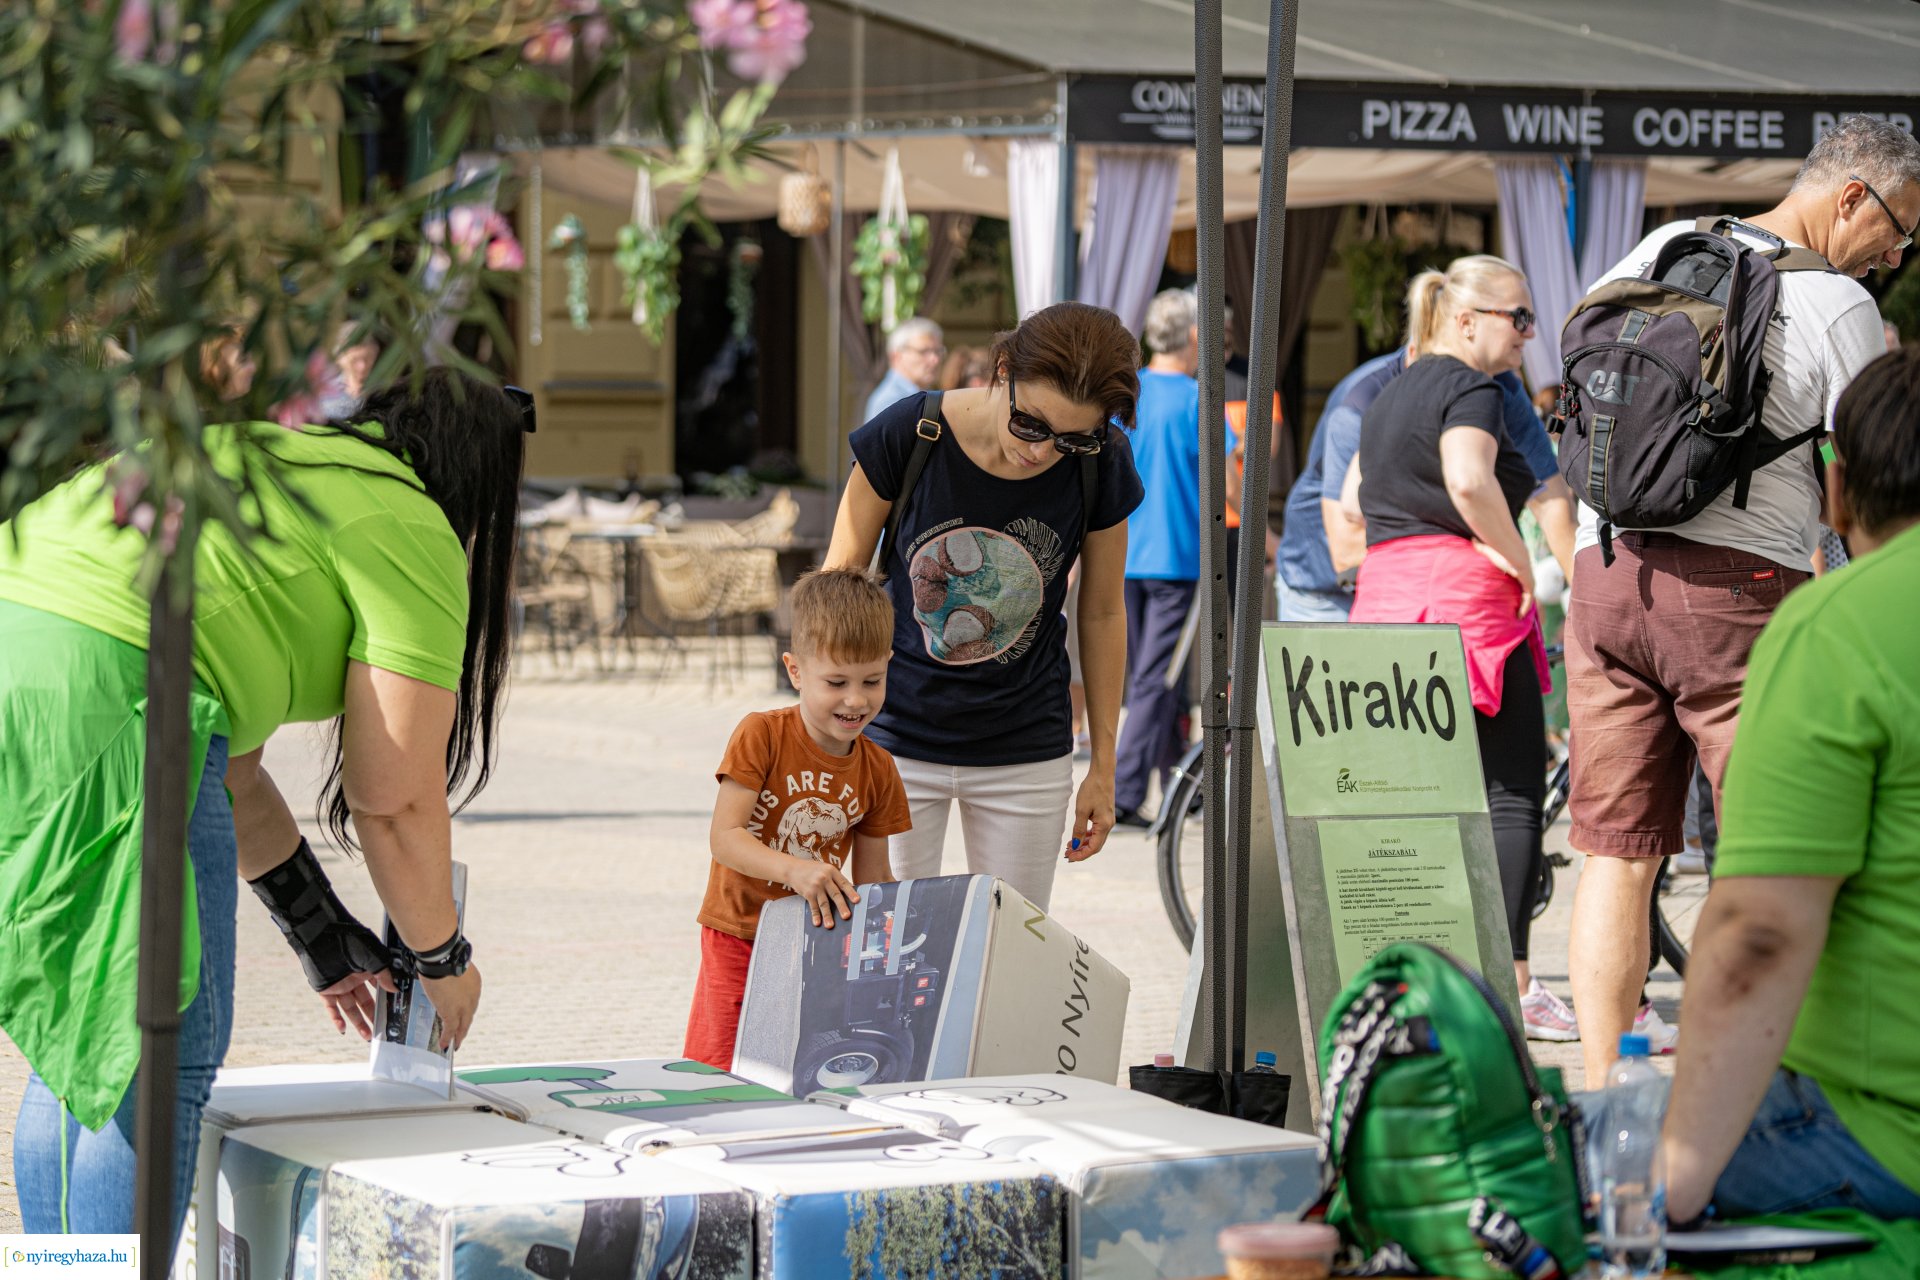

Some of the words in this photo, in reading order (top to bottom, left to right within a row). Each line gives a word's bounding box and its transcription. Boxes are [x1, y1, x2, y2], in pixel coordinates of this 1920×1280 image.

[1362, 100, 1477, 142] PIZZA
[1502, 104, 1604, 145] WINE
[1633, 107, 1785, 149] COFFEE
[1586, 370, 1650, 406] CAT
[1282, 646, 1457, 747] Kirakó
[786, 770, 833, 796] ARE
[1367, 848, 1418, 857] JÁTÉKSZABÁLY
